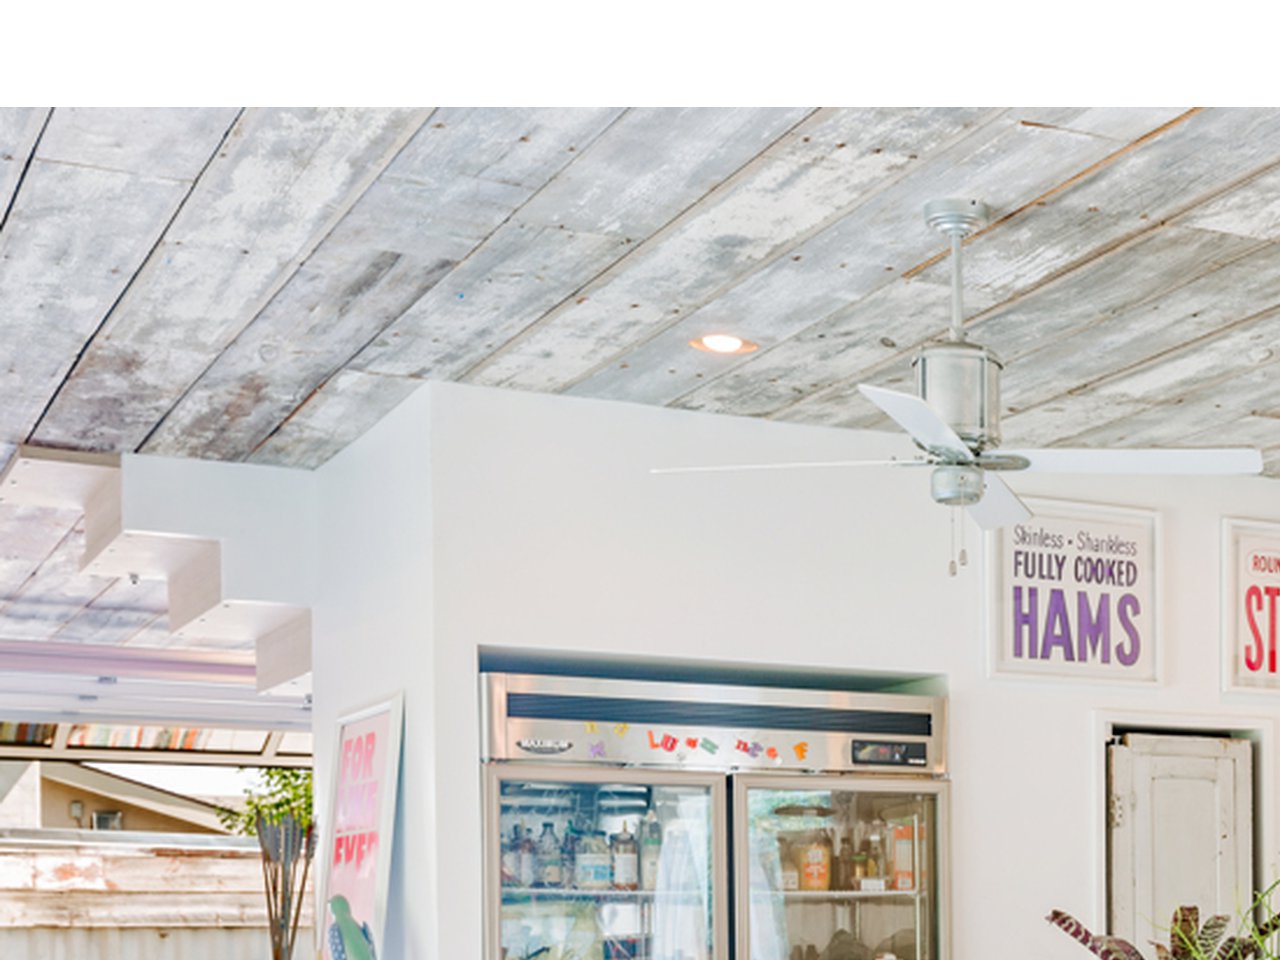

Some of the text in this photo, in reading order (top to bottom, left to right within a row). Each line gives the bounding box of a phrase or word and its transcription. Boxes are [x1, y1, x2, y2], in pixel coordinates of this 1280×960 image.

[1013, 524, 1137, 557] Skinless Shankless
[1013, 550, 1138, 587] FULLY COOKED
[1013, 585, 1141, 667] HAMS
[341, 731, 377, 785] FOR
